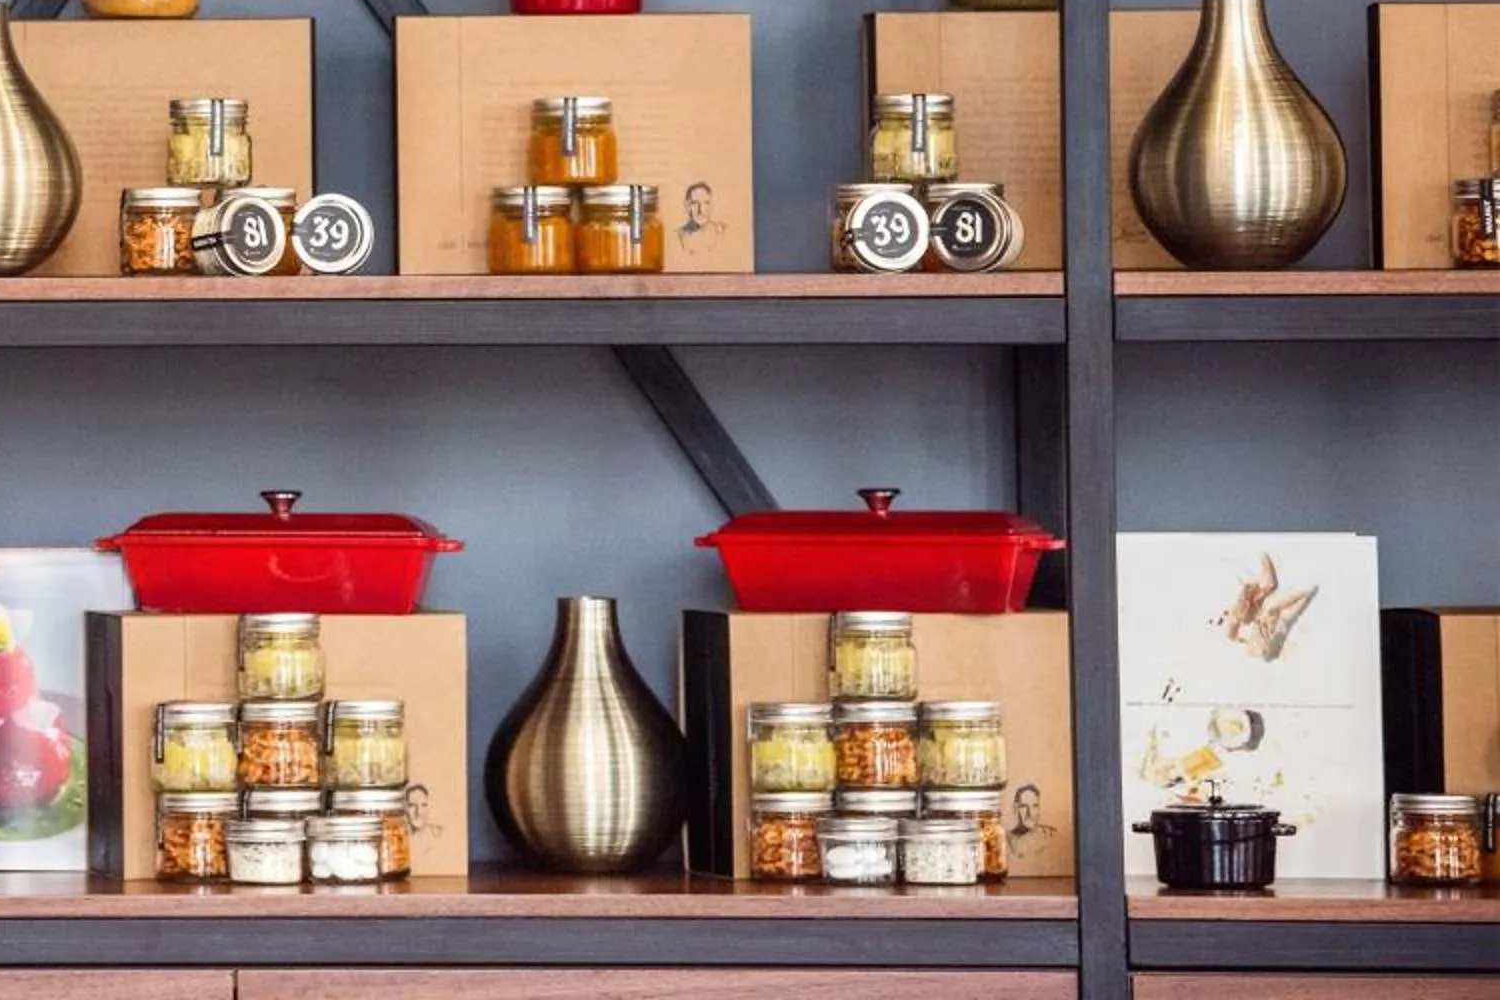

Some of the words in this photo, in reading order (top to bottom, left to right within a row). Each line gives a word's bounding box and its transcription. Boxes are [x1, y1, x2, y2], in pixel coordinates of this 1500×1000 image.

[243, 215, 269, 248] 81
[309, 215, 349, 249] 39
[870, 213, 911, 247] 39
[955, 212, 983, 244] 81
